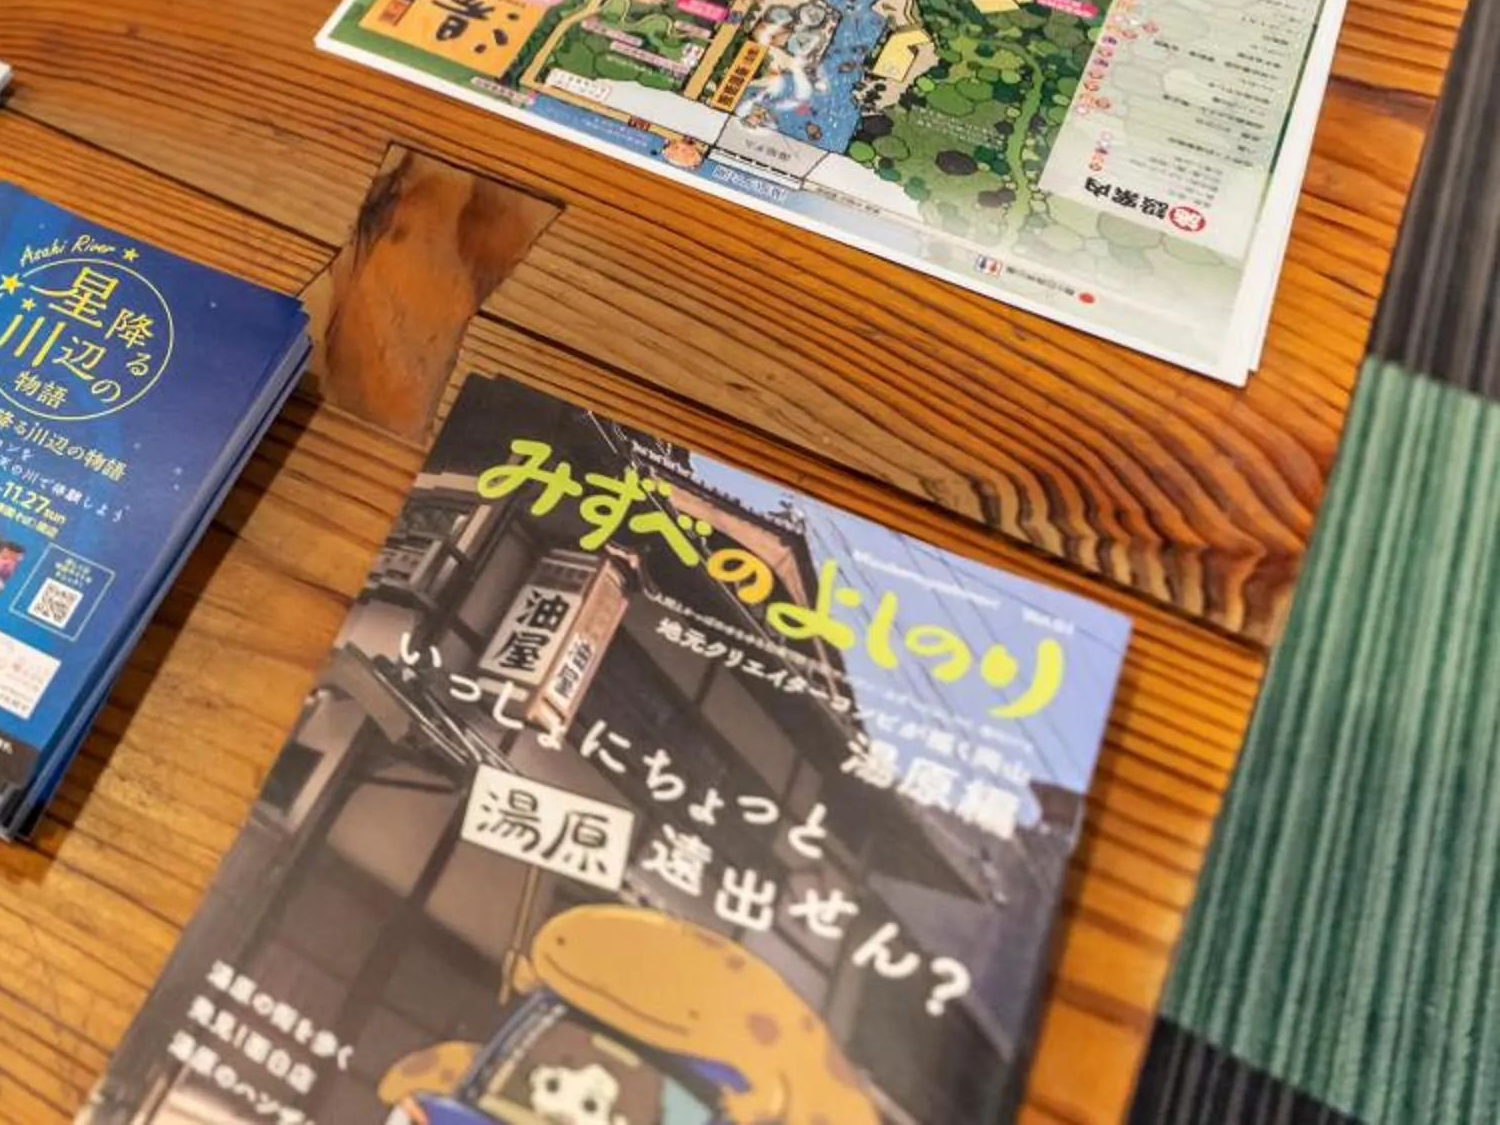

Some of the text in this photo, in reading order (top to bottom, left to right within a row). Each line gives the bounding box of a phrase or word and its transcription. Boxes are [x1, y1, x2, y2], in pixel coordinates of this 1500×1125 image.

[476, 438, 1065, 719] みずべのよしのり
[492, 588, 570, 672] 油屋
[477, 787, 611, 876] 湯原
